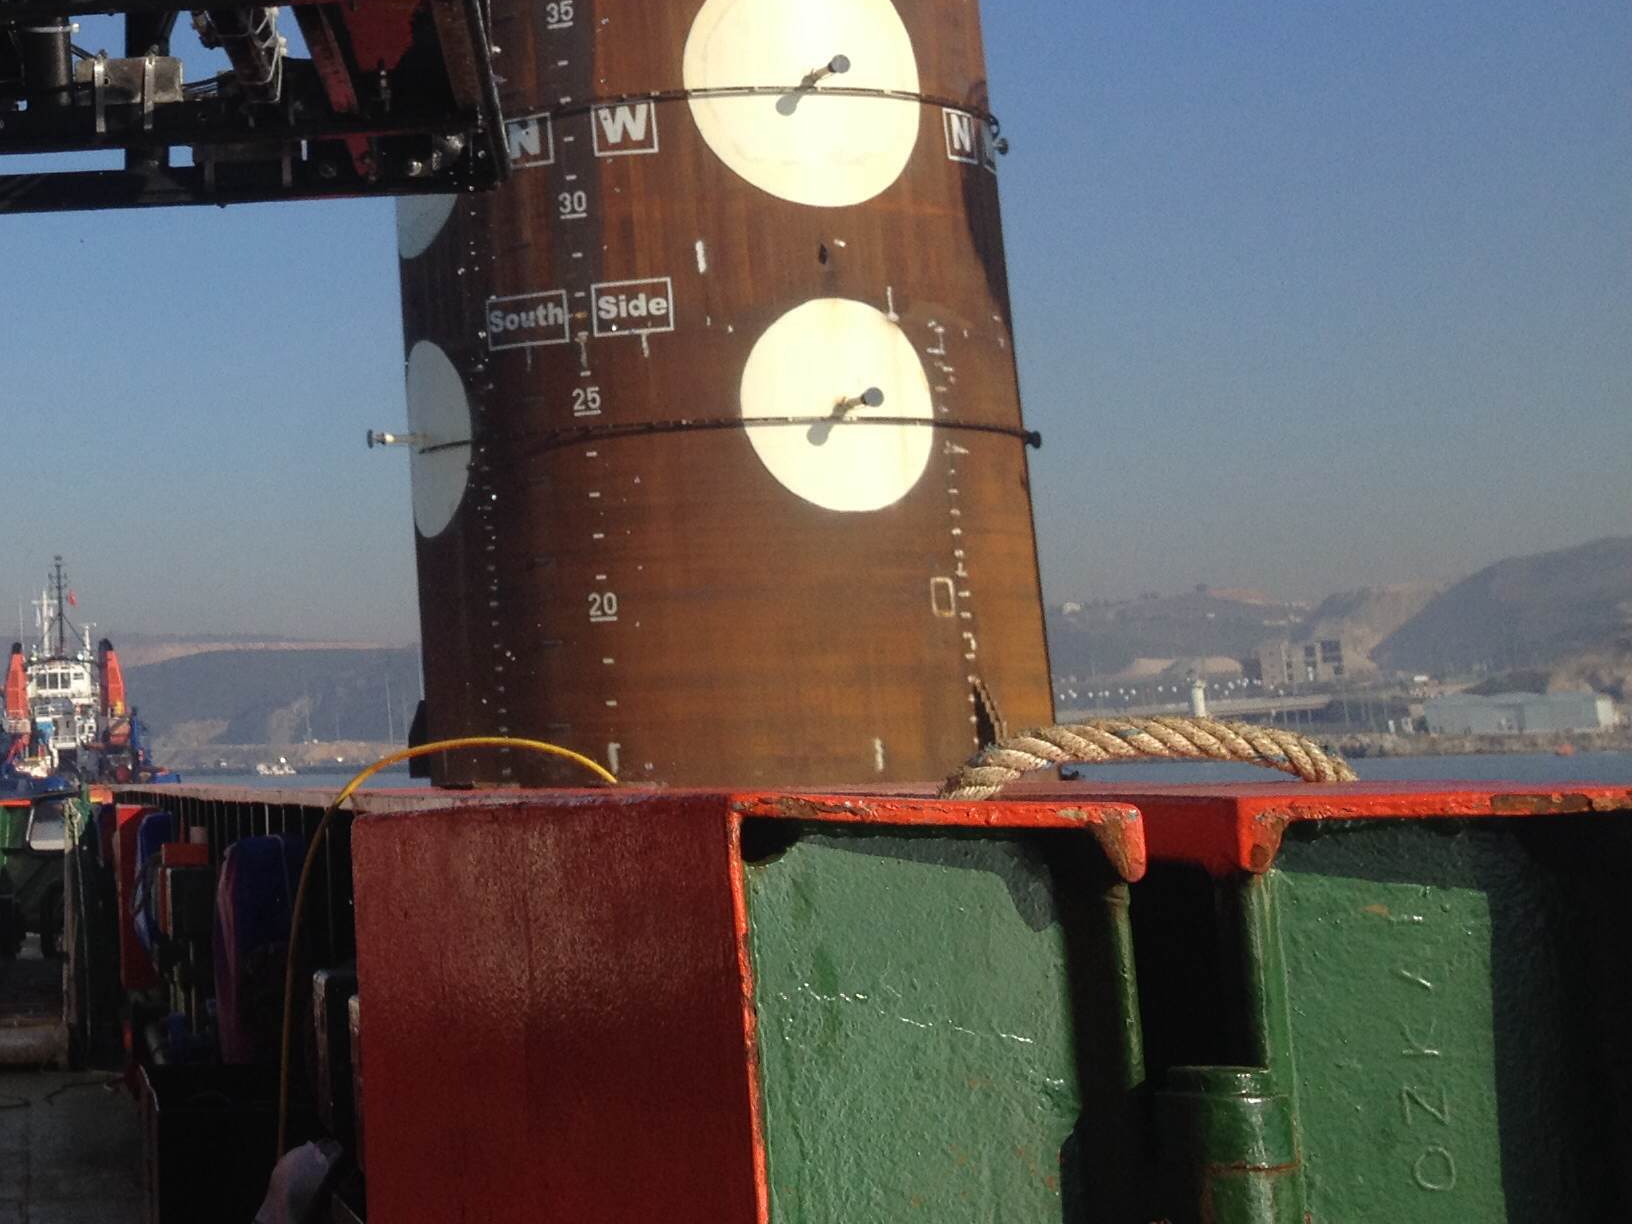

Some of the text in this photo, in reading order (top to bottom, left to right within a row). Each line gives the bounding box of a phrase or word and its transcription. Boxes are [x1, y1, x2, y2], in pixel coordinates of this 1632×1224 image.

[546, 0, 574, 24] 35
[597, 102, 649, 145] W
[949, 113, 972, 153] N
[558, 190, 588, 214] 30
[489, 292, 668, 334] South Side
[571, 386, 602, 411] 25
[587, 592, 617, 618] 20
